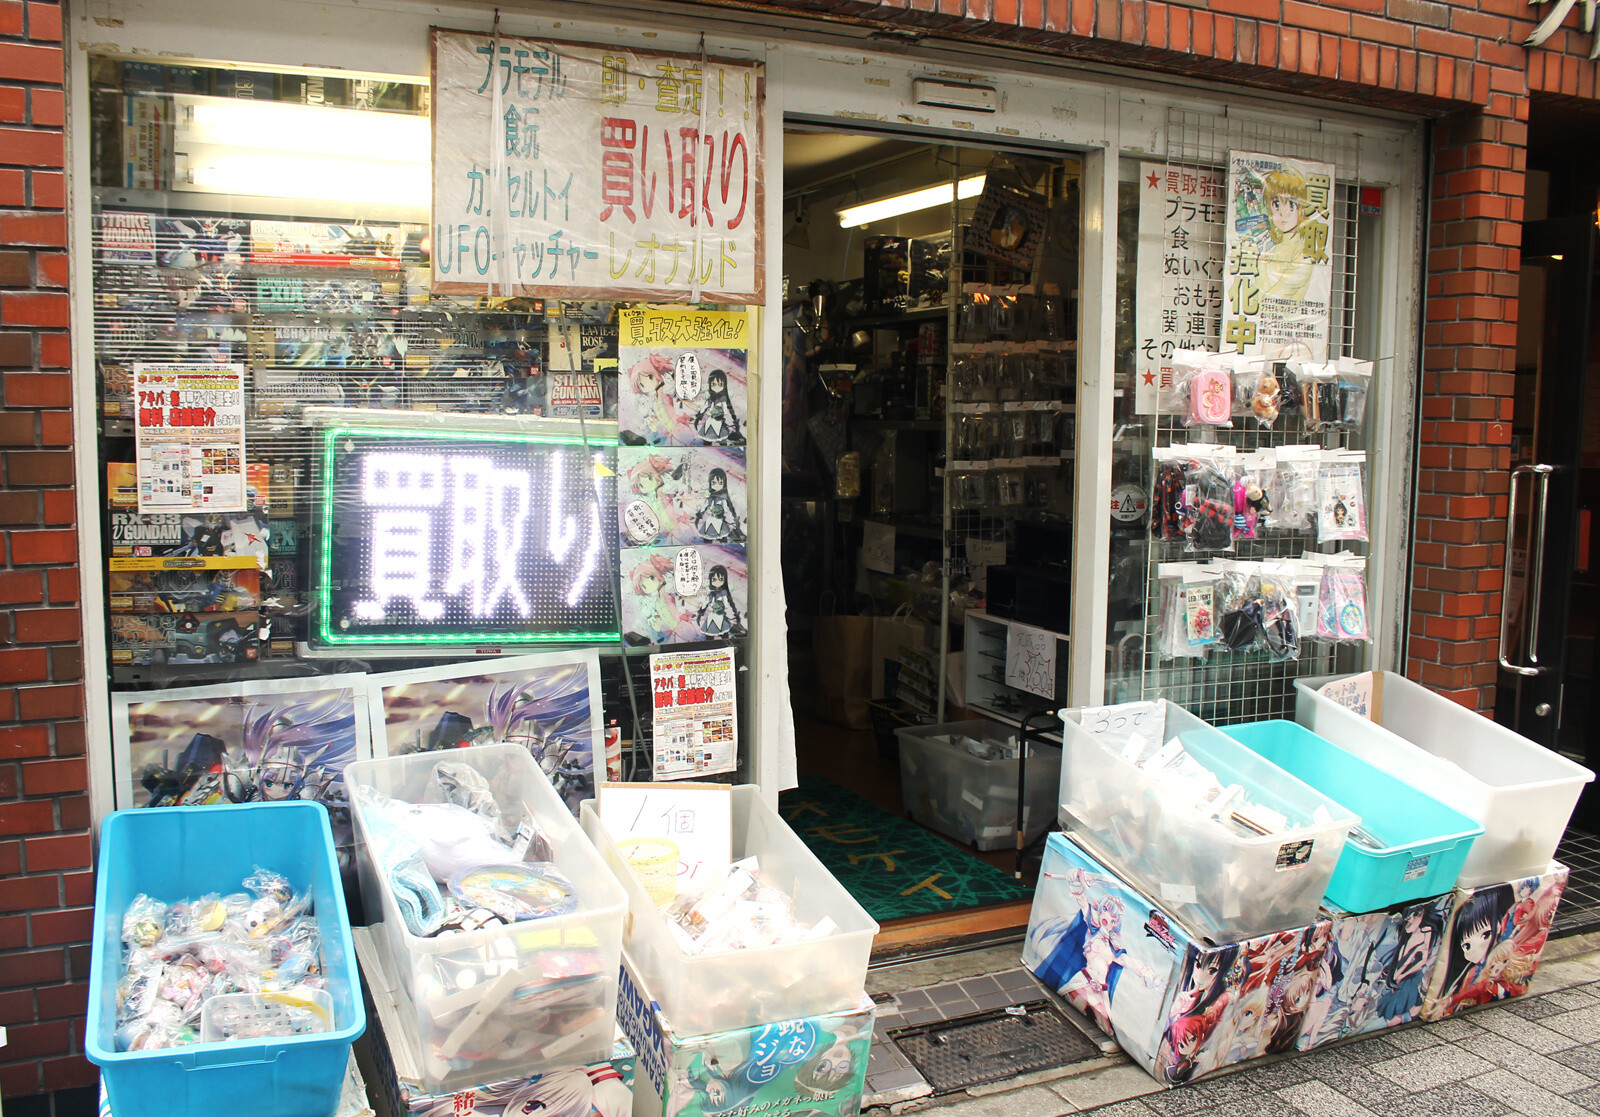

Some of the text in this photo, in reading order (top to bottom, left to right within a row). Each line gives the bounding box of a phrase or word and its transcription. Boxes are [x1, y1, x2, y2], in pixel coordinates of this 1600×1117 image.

[504, 104, 539, 159] 食玩
[466, 163, 573, 221] カセルトイ
[600, 117, 748, 229] 買い取り
[1303, 172, 1330, 264] 買取
[609, 232, 737, 287] レオナルド
[1164, 253, 1224, 280] ぬいぐ
[1225, 240, 1260, 355] 強化中
[112, 513, 181, 525] RX-93
[355, 450, 604, 620] 買取り
[1095, 709, 1147, 733] 3つで
